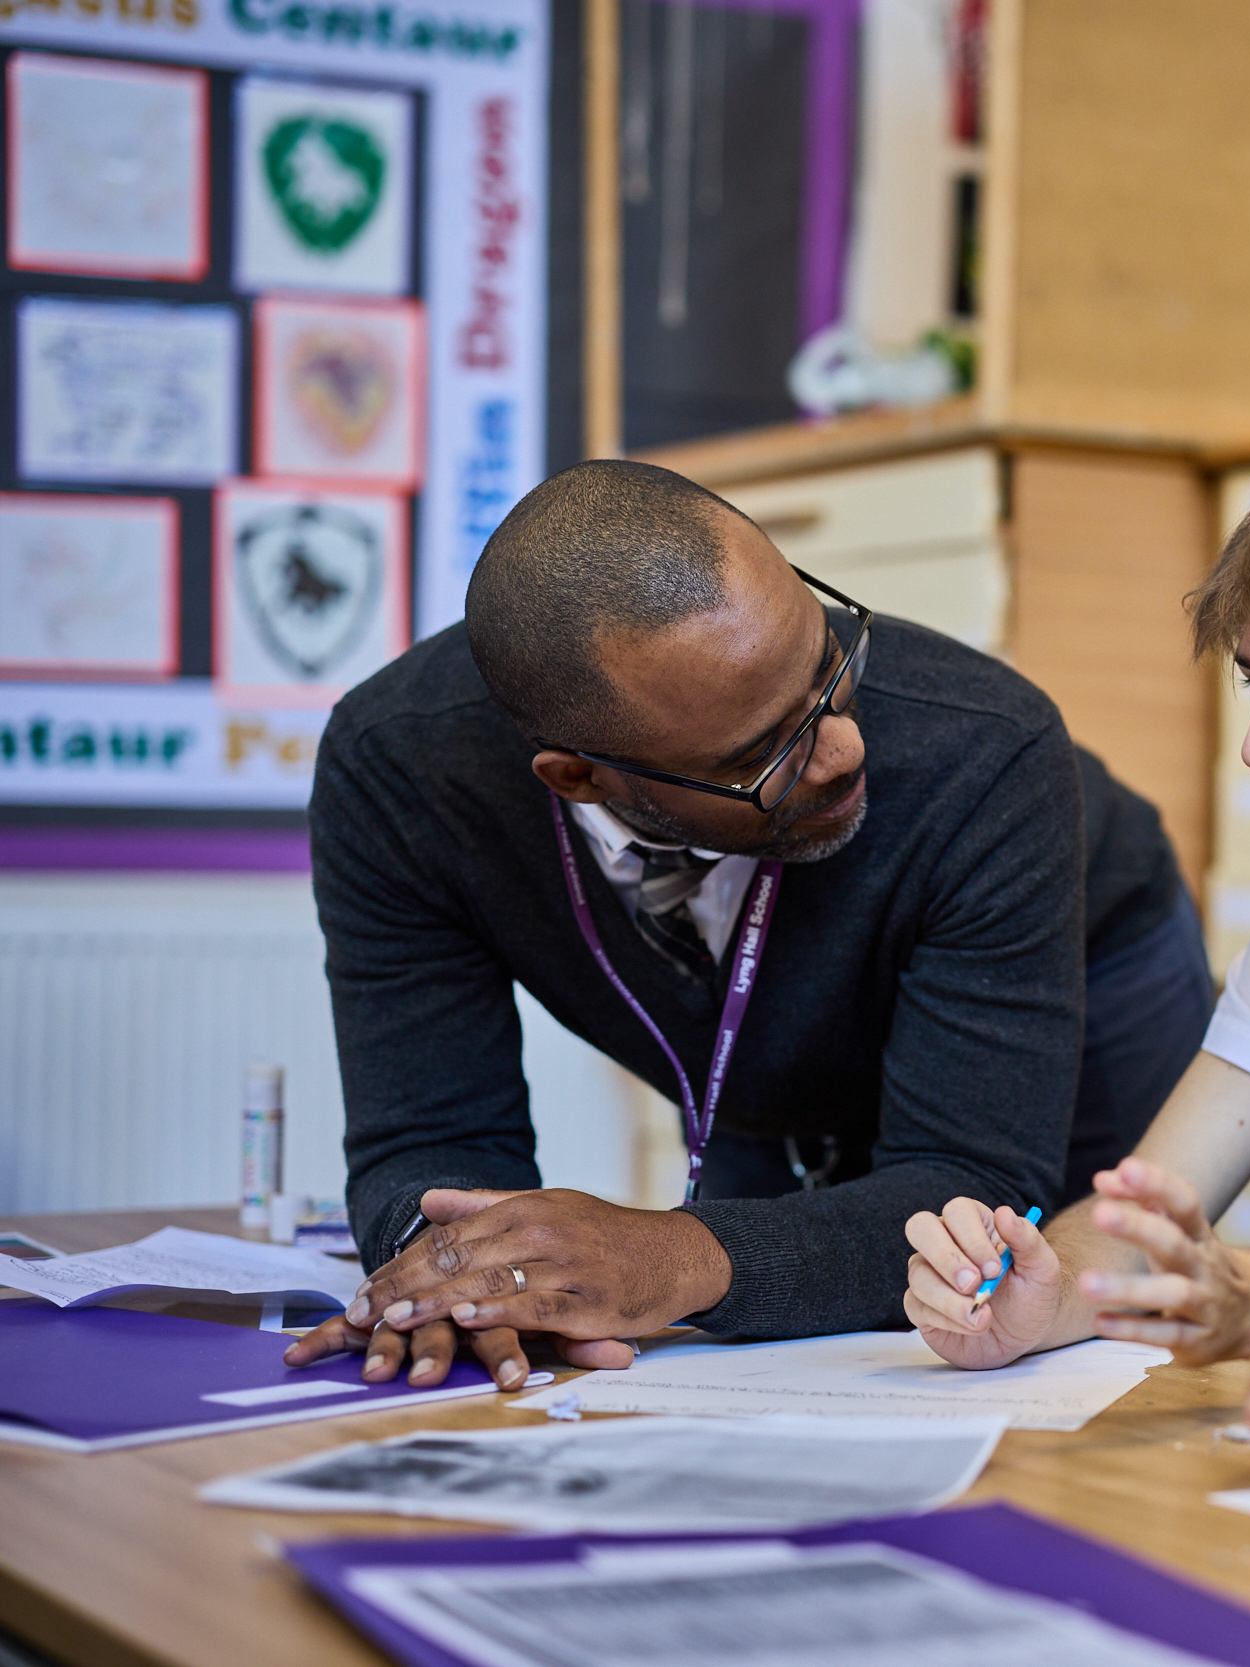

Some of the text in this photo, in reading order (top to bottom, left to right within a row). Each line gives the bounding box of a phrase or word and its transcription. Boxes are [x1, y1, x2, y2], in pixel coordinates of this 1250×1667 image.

[458, 96, 519, 371] Dragon
[733, 874, 774, 994] Lyng Hall School
[713, 1029, 734, 1079] School
